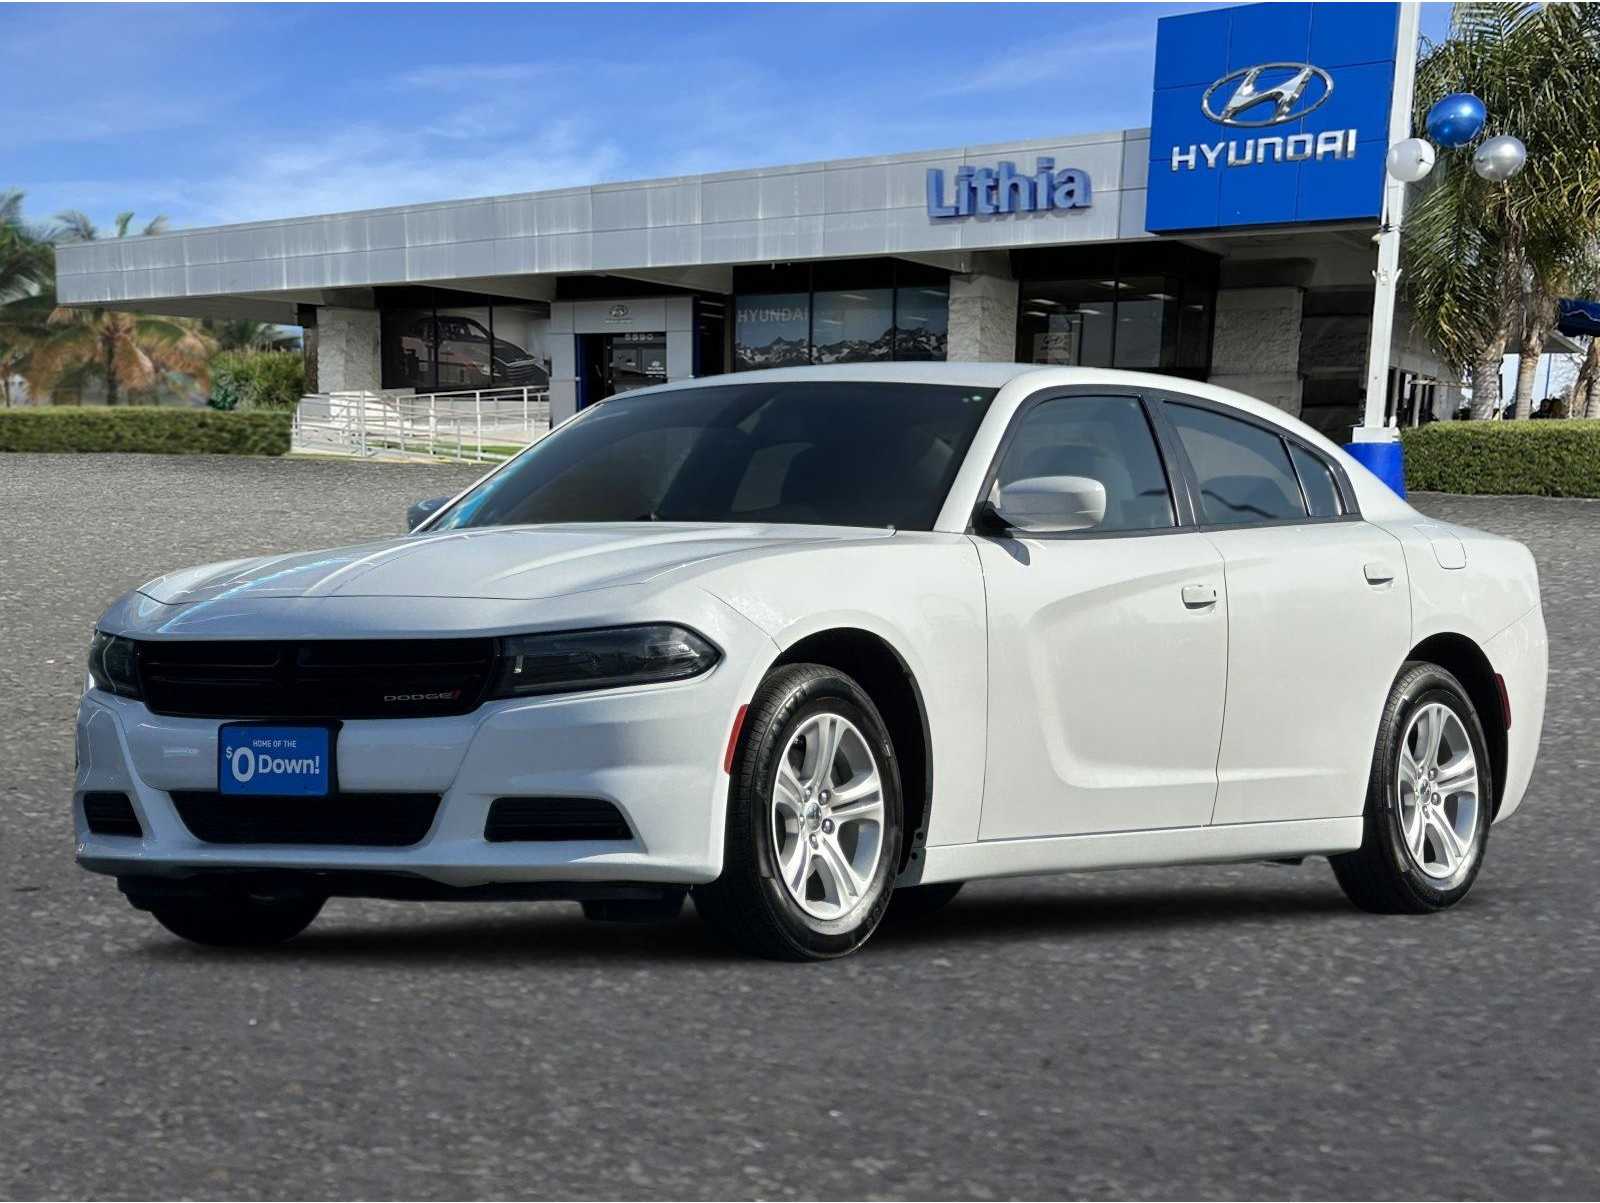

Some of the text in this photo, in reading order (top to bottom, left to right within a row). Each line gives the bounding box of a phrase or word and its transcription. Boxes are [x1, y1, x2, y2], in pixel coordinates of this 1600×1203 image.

[1171, 129, 1357, 171] HYUNDAI
[926, 156, 1092, 217] Lithia
[737, 308, 809, 322] HYUNDAI
[383, 692, 453, 702] DODGE
[258, 755, 320, 774] Down!
